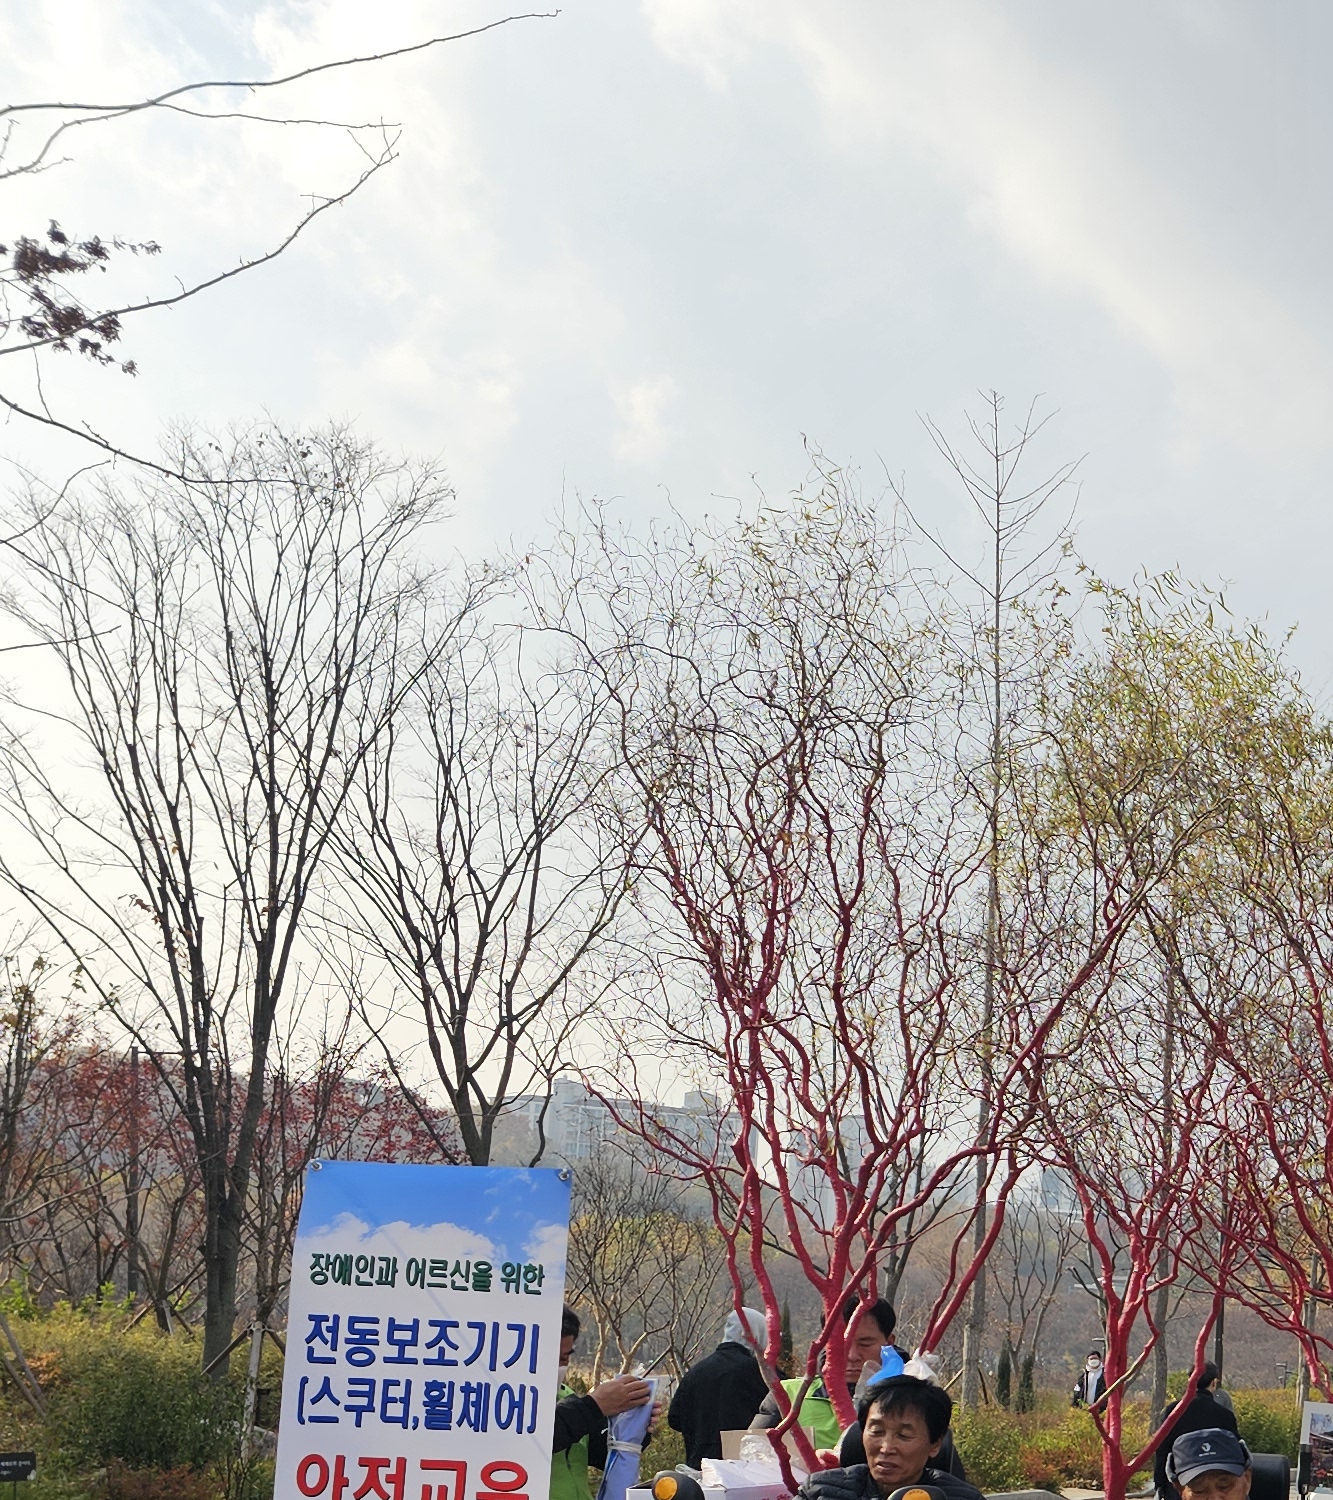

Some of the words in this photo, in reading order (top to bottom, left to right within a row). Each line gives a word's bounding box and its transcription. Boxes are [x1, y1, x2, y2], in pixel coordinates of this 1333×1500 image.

[309, 1253, 399, 1288] 장애인과
[405, 1257, 492, 1293] 어르신을
[500, 1261, 546, 1296] 위한
[304, 1313, 540, 1374] 전동보조기기
